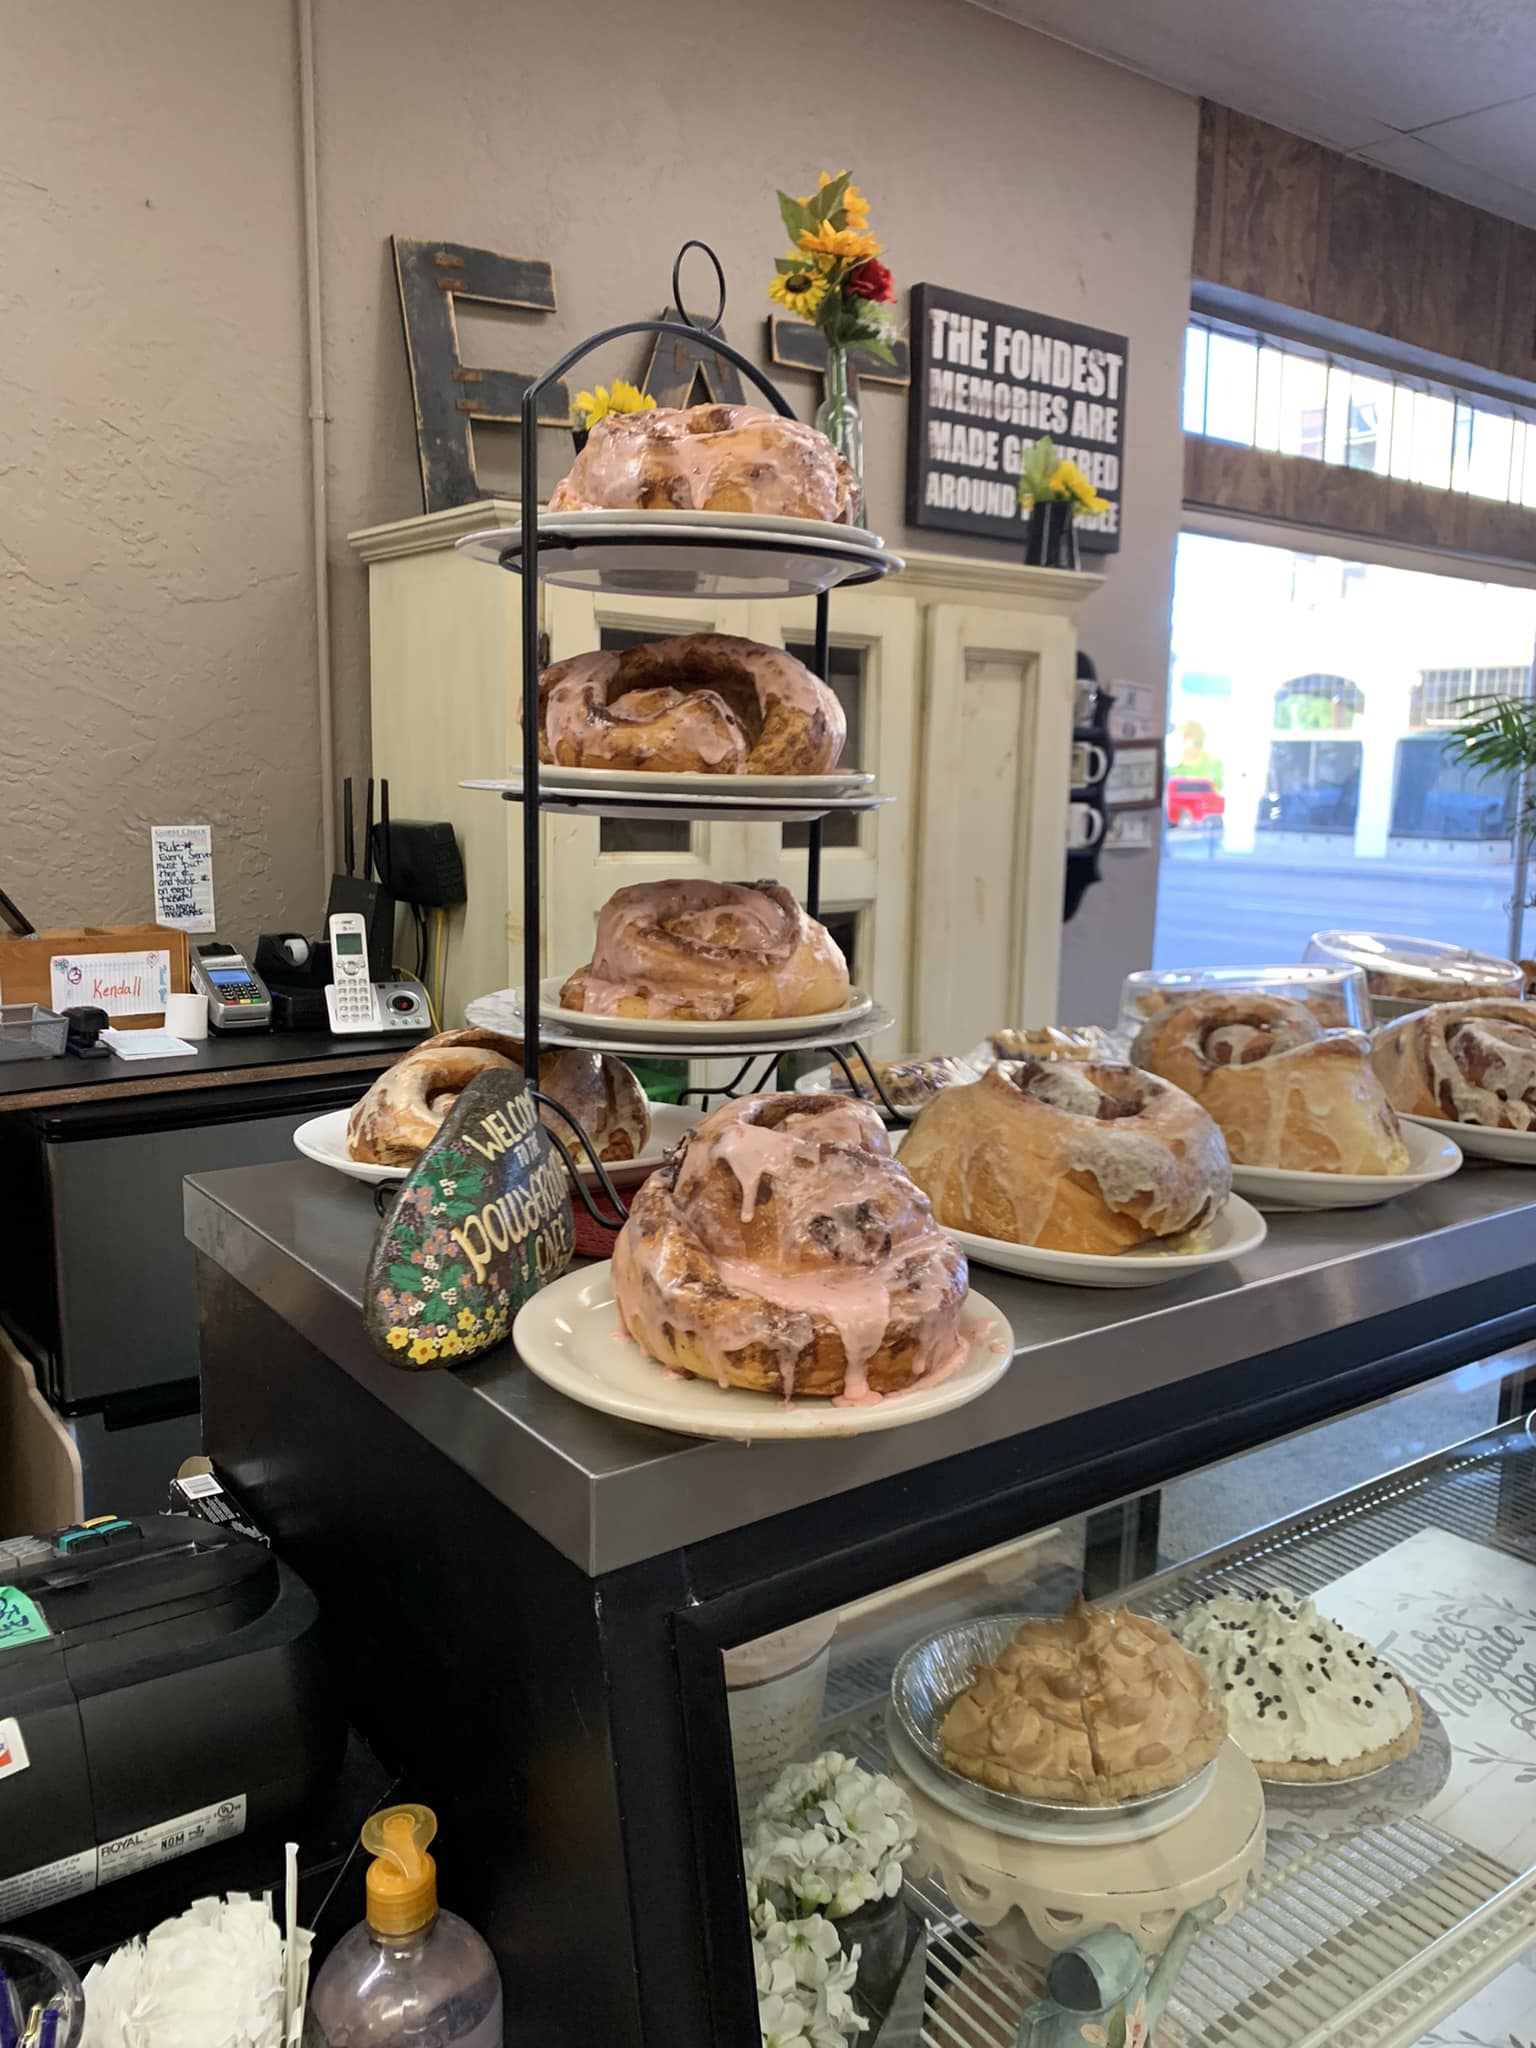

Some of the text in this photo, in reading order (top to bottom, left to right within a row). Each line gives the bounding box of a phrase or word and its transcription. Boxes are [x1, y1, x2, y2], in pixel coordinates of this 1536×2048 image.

[928, 308, 1123, 400] THE FONDEST
[929, 368, 1118, 444] MEMORIES ARE
[929, 421, 999, 470] MADE
[926, 472, 1017, 519] AROUND
[92, 976, 142, 999] Kendall
[100, 1835, 143, 1857] ROYAL
[161, 1833, 185, 1849] NOM
